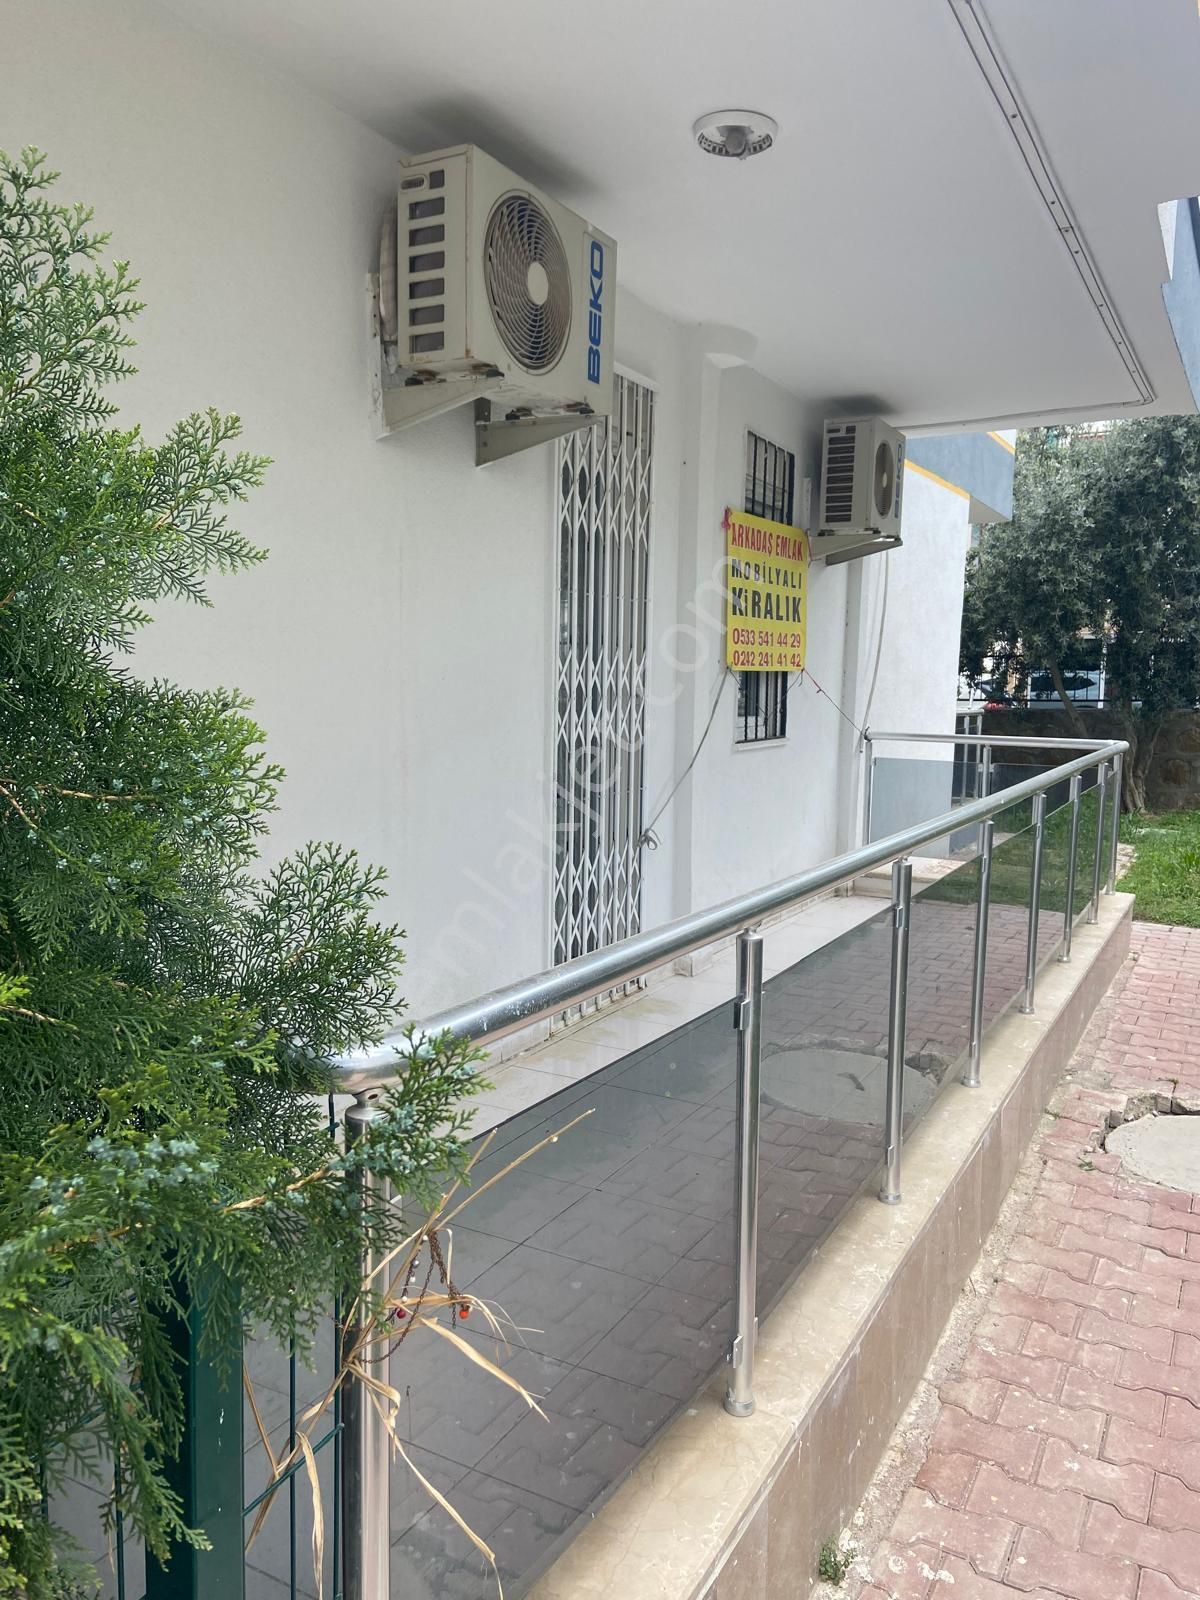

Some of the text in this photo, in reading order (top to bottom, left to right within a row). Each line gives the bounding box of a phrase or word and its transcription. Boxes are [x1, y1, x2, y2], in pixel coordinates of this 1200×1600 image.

[587, 240, 604, 385] BEKO
[731, 522, 804, 562] ARKADAŞ EMLAK
[732, 627, 801, 649] 0533 541 44 29
[732, 650, 802, 668] 0242 241 41 42
